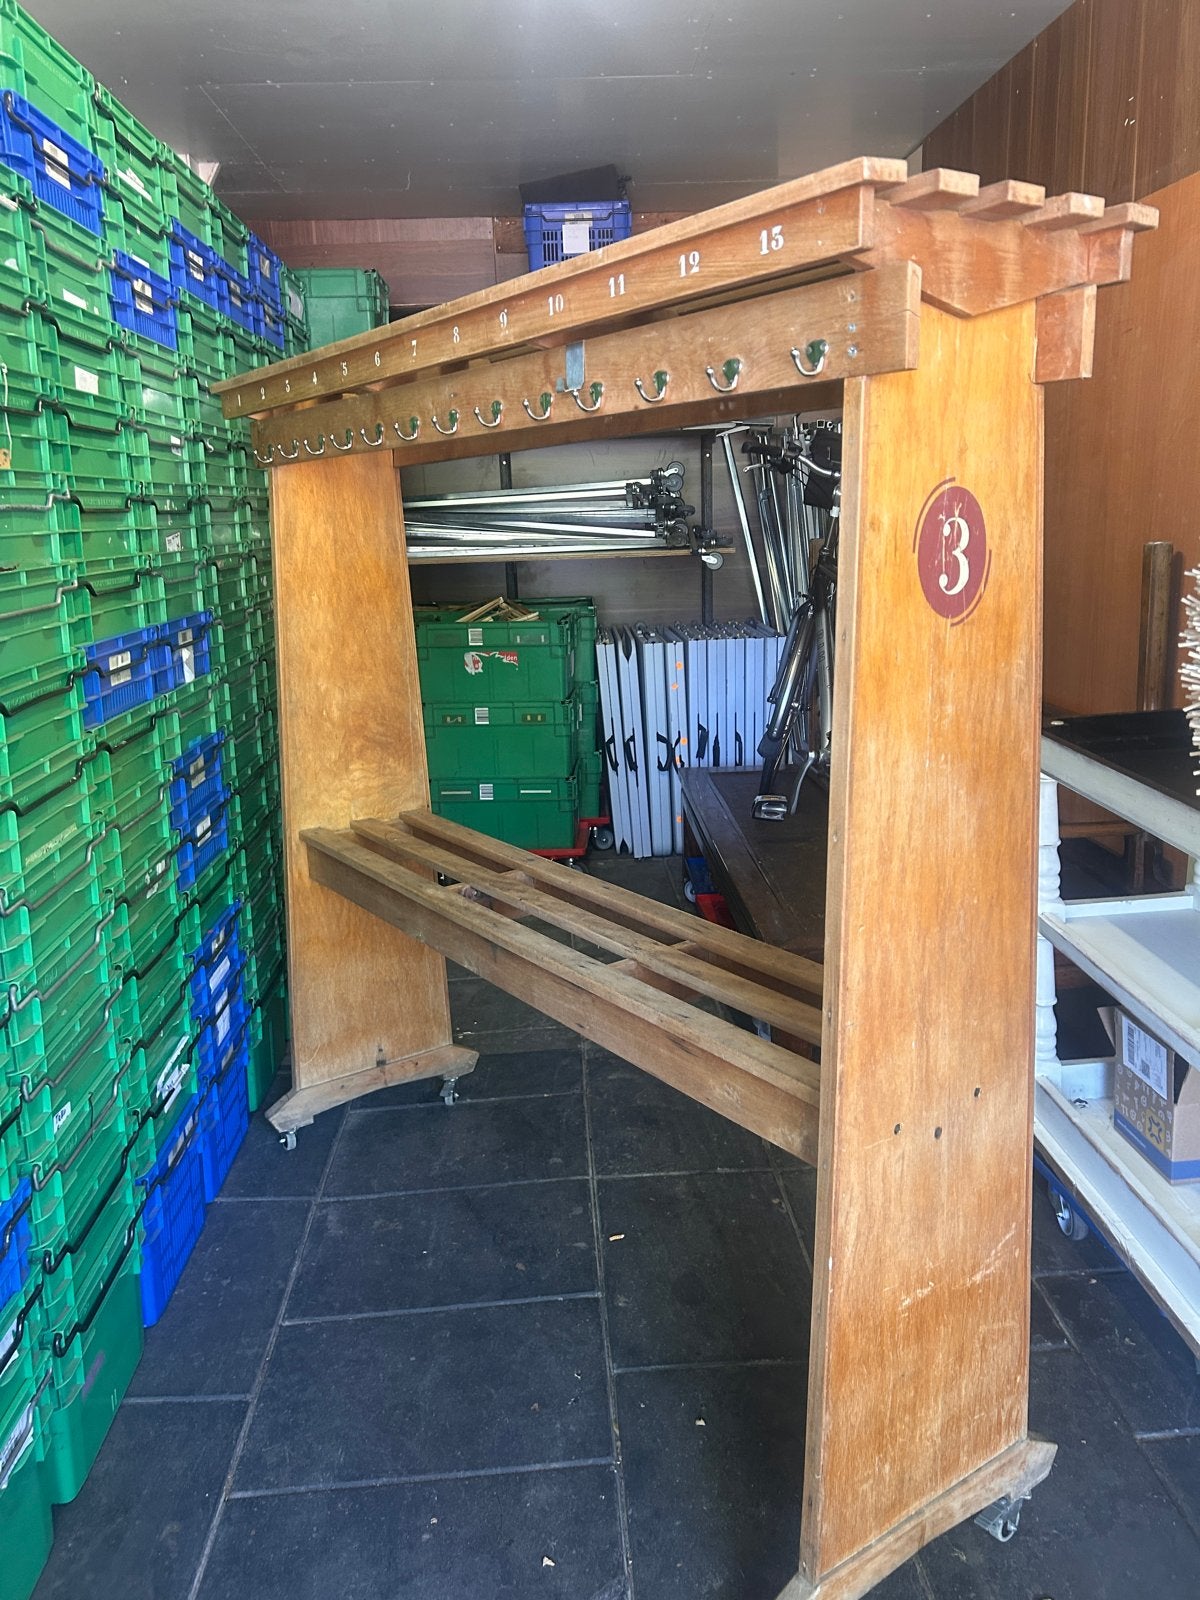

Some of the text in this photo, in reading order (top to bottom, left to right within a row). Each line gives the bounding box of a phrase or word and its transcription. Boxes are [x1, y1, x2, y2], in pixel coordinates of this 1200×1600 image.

[759, 225, 784, 255] 13
[678, 251, 700, 278] 12
[608, 274, 626, 298] 11
[548, 294, 564, 316] 10
[500, 308, 508, 328] 9
[453, 326, 460, 344] 8
[411, 339, 417, 356] 7
[374, 351, 381, 367] 6
[312, 371, 318, 385] 4
[340, 362, 348, 376] 5
[260, 387, 266, 400] 2
